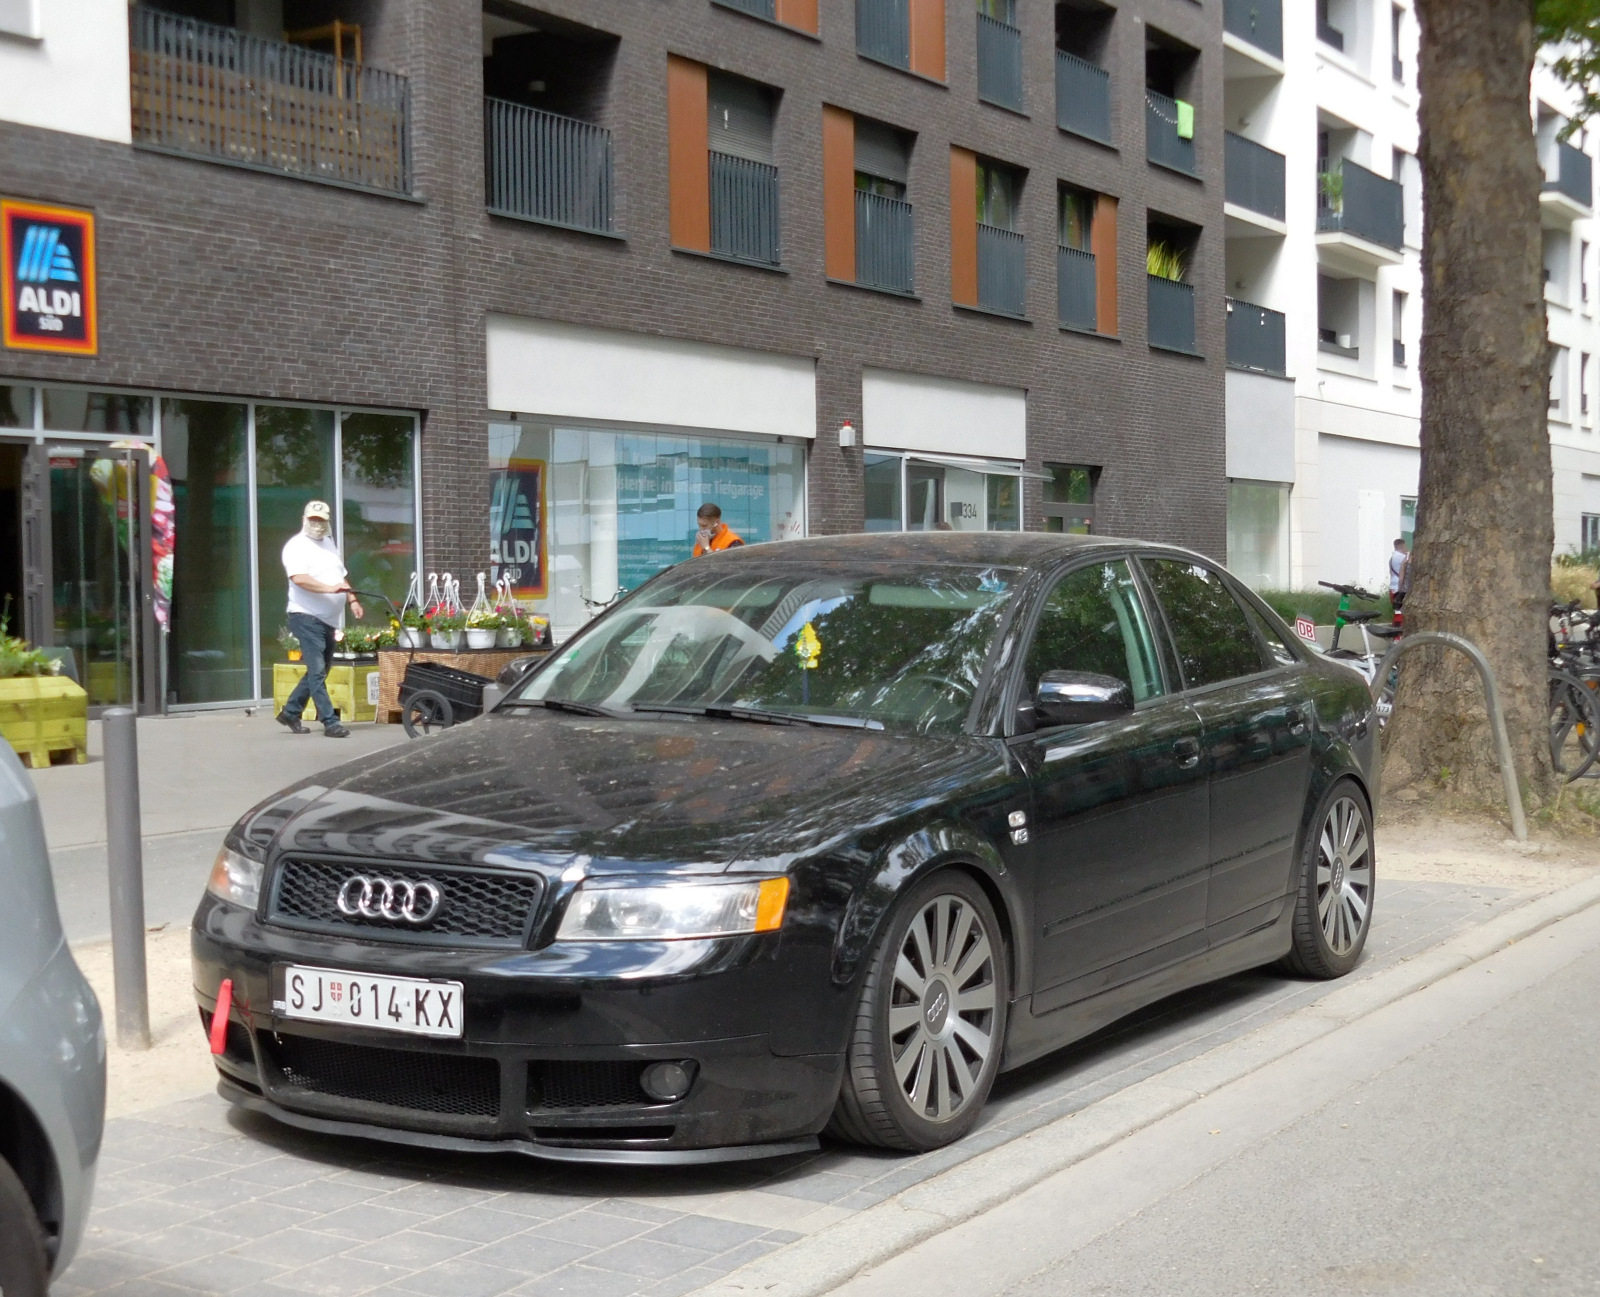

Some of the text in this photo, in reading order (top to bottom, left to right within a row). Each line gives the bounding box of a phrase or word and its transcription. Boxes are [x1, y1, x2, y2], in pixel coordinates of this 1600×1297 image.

[18, 285, 81, 318] ALDI
[714, 480, 764, 500] Tiefgarage
[962, 503, 977, 519] 334
[490, 540, 536, 564] ALDI
[1299, 621, 1314, 638] DB
[291, 974, 323, 1012] SJ
